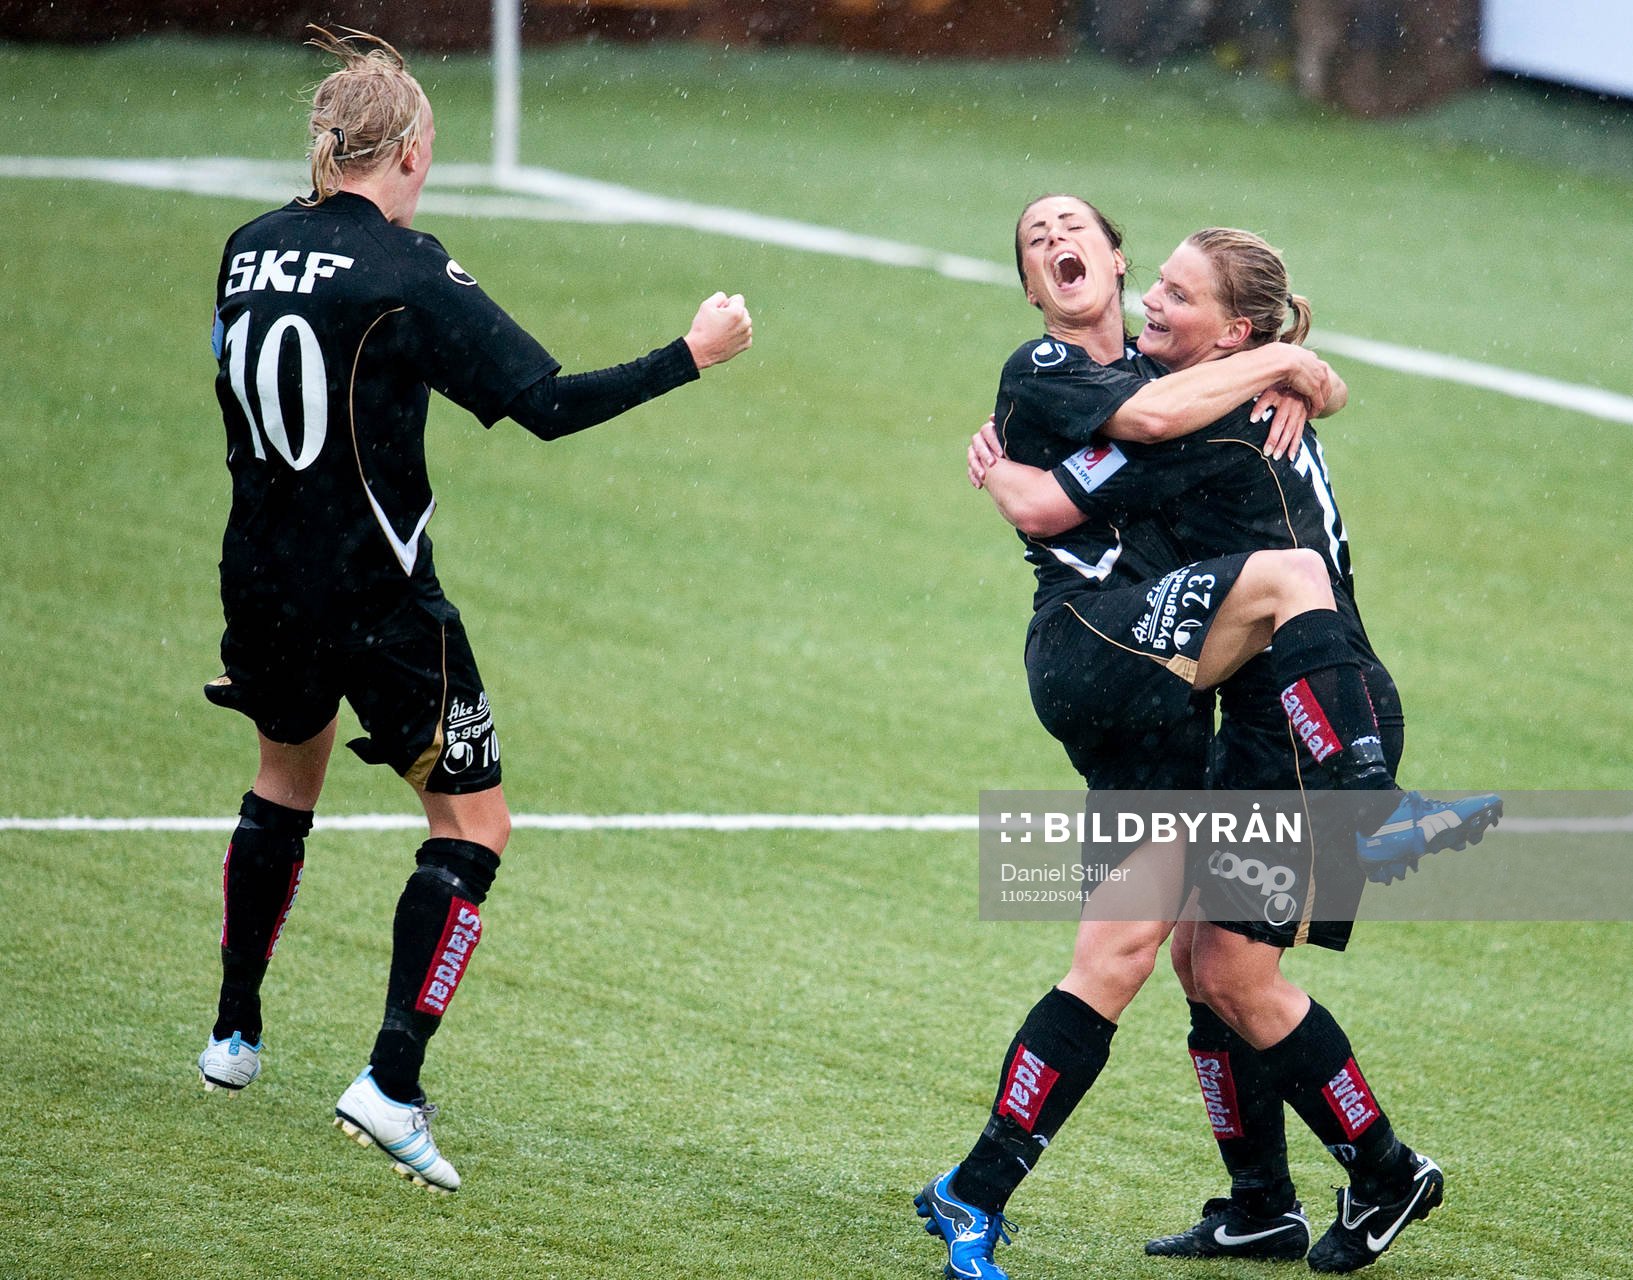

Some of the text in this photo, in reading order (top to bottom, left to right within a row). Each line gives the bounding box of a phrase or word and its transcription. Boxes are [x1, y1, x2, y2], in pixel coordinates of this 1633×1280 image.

[225, 250, 355, 297] SKF
[225, 310, 328, 471] 10
[1181, 573, 1216, 610] 23
[1131, 612, 1152, 645] Åke
[446, 695, 474, 723] Åke
[1280, 681, 1335, 763] tavdal
[481, 730, 500, 768] 10
[423, 906, 481, 1011] Stavdal
[1194, 1055, 1235, 1133] Stavdal
